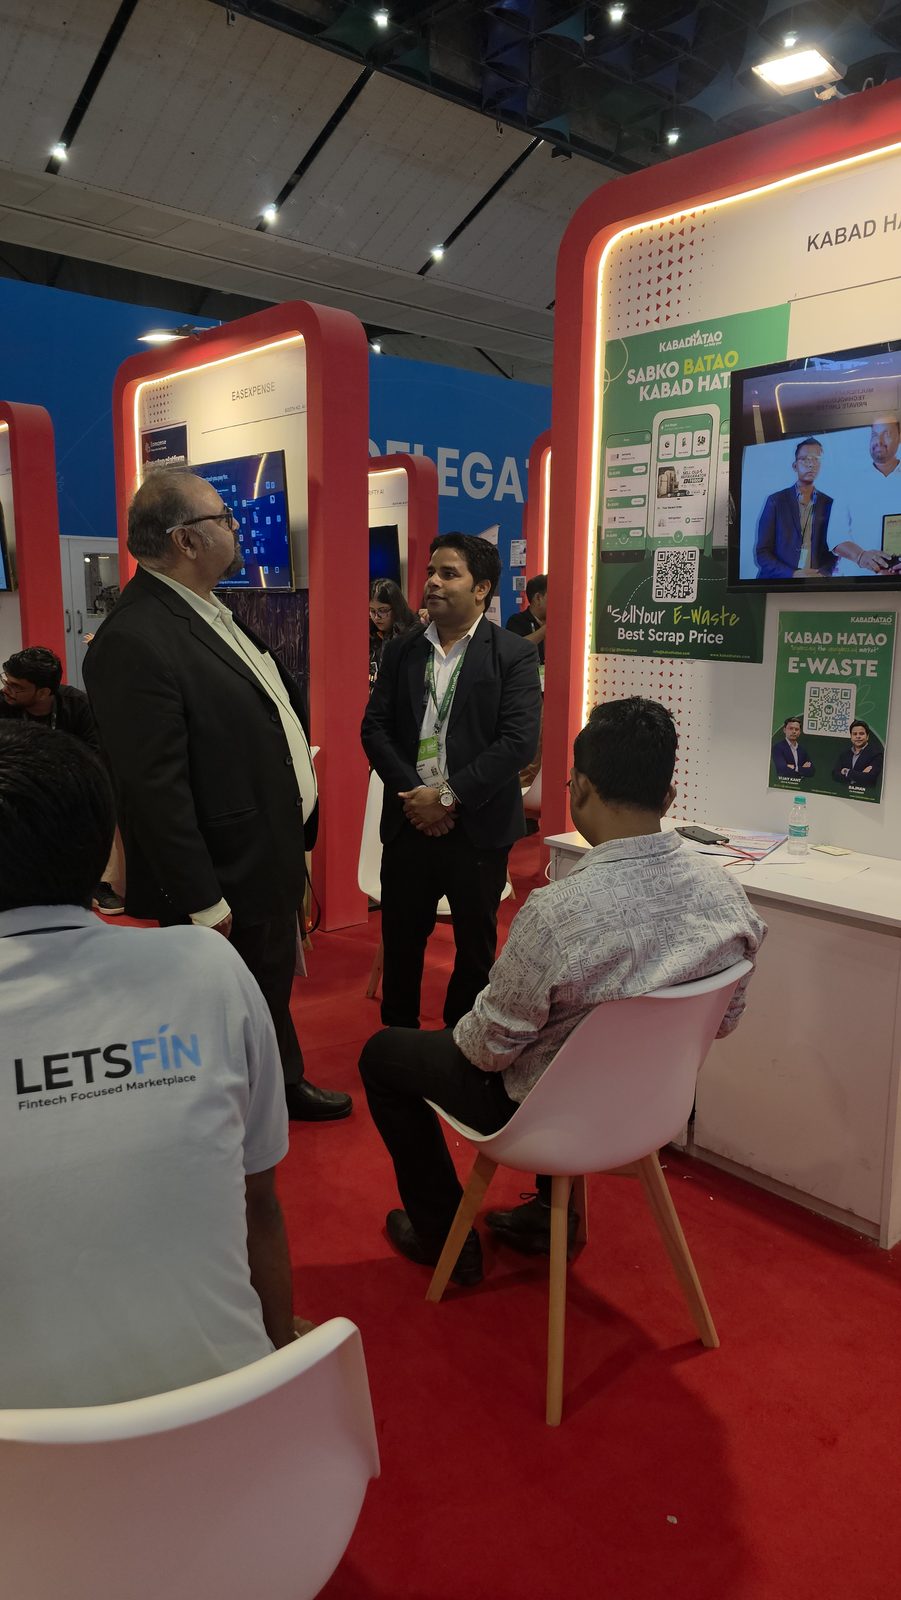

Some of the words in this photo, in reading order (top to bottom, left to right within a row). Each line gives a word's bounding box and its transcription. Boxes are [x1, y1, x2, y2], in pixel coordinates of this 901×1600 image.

[807, 219, 877, 252] KABAD
[627, 361, 680, 385] SABKO
[683, 350, 739, 376] BATAO
[231, 381, 276, 401] EASEXPENSE
[639, 378, 694, 401] KABAD
[698, 371, 731, 393] HAT
[673, 605, 740, 626] E-Waste
[617, 627, 645, 641] Best
[648, 629, 685, 645] Scrap
[688, 629, 724, 644] Price
[784, 632, 833, 645] KABAD
[836, 633, 888, 647] HATAO
[788, 657, 879, 677] E-WASTE
[18, 1095, 67, 1110] Fintech
[71, 1085, 123, 1102] Focused
[126, 1073, 197, 1091] Marketplace
